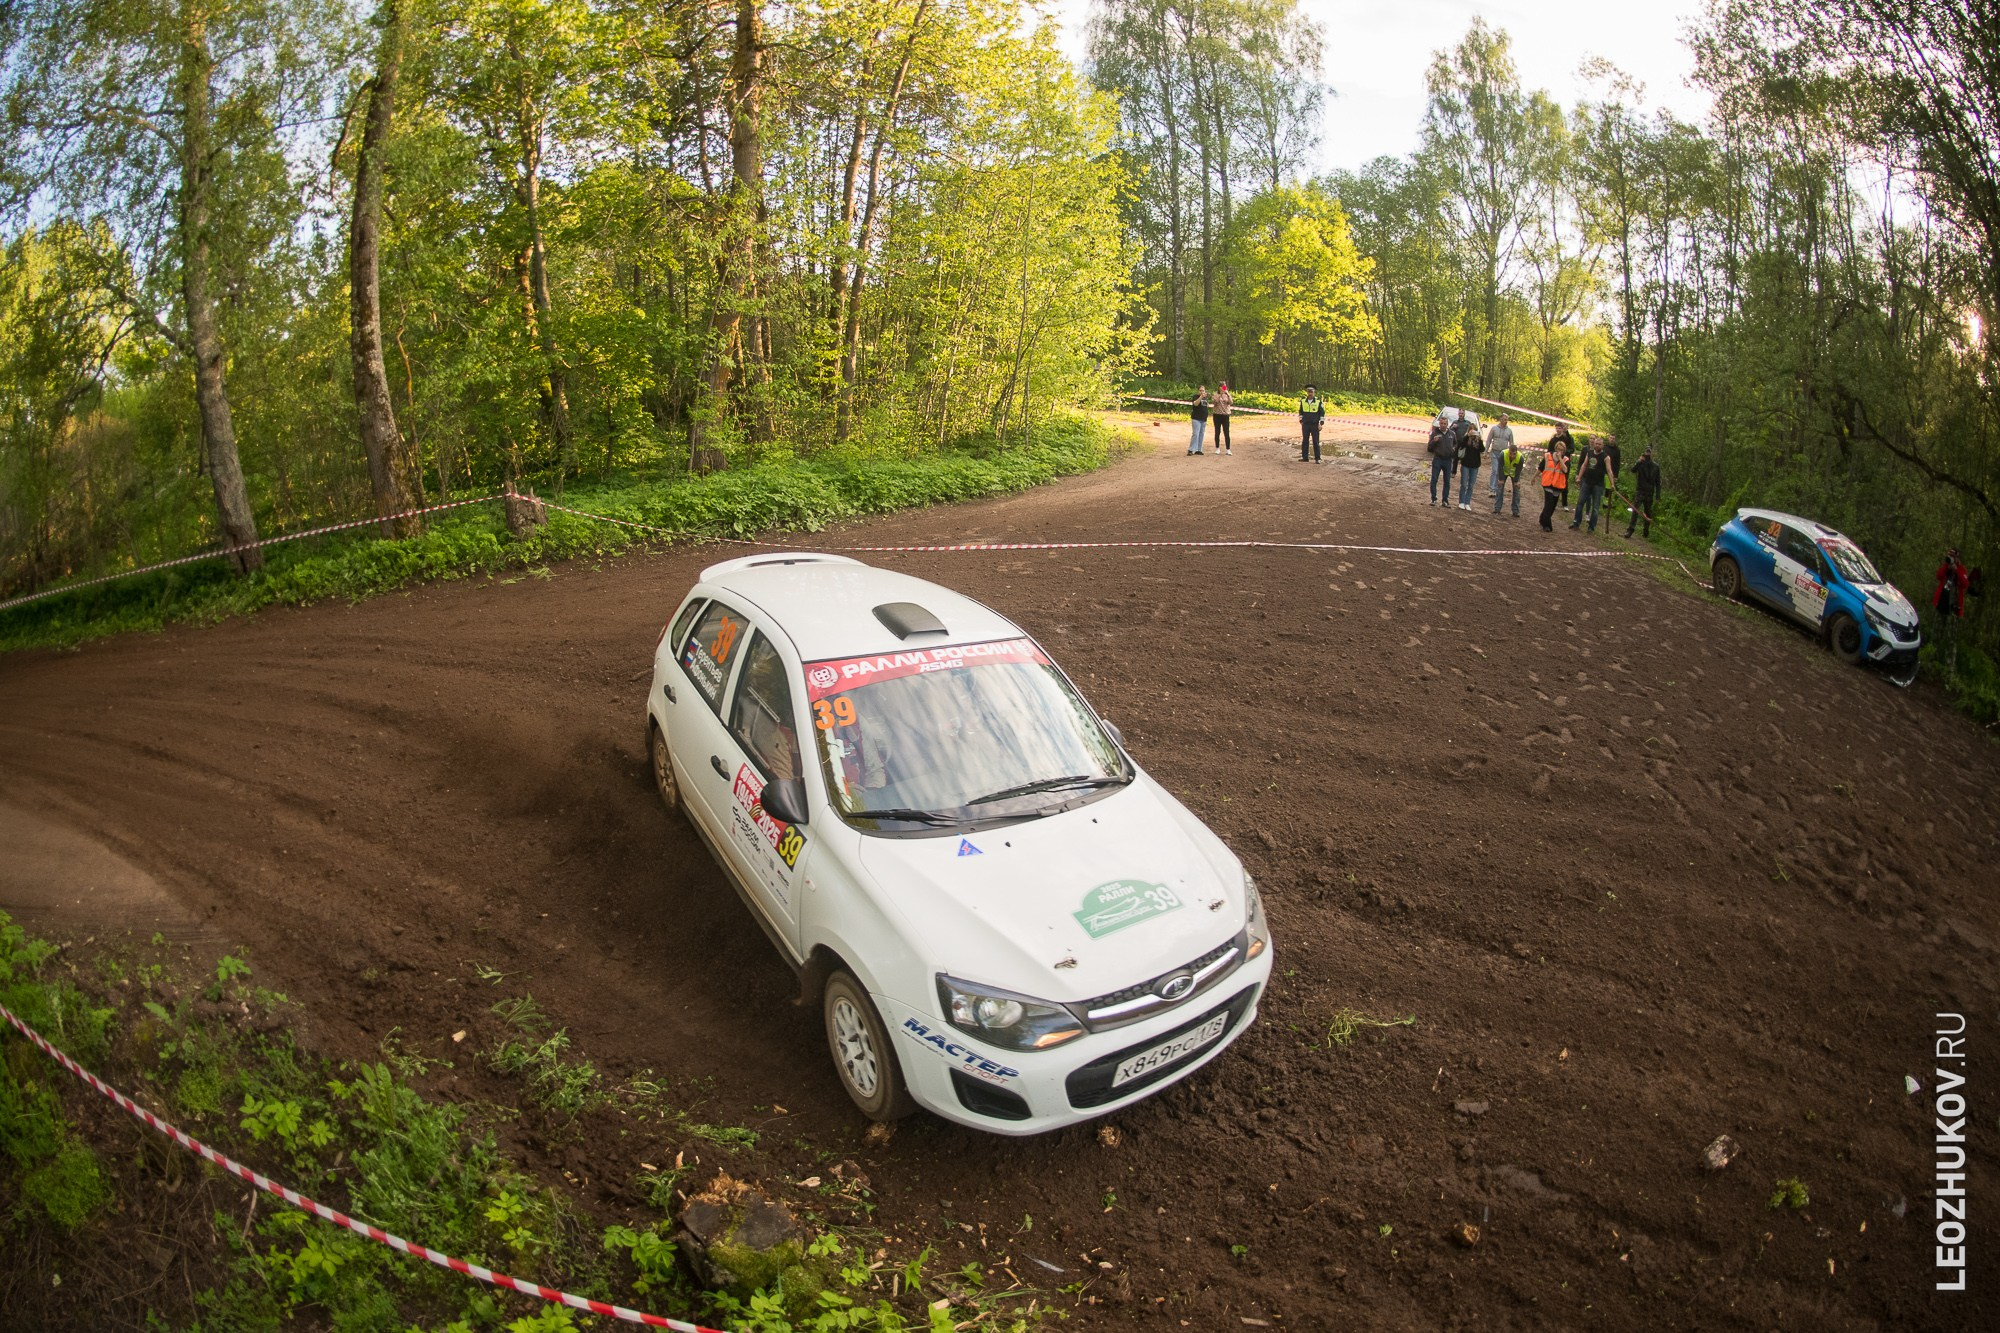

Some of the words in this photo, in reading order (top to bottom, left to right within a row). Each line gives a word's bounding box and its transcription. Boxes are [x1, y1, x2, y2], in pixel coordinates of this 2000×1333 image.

[1818, 587, 1828, 599] 32
[711, 616, 737, 664] 39
[695, 642, 723, 683] Терентьев
[841, 652, 926, 679] РАЛЛИ
[929, 643, 1014, 661] РОССИИ
[813, 696, 857, 730] 39
[735, 780, 754, 812] 1945
[757, 810, 781, 848] 2025
[779, 826, 803, 866] 39
[1098, 885, 1136, 904] РАЛЛИ
[1144, 886, 1180, 911] 39
[903, 1017, 1020, 1078] МАСТЕР
[963, 1063, 1009, 1084] СПОРТ
